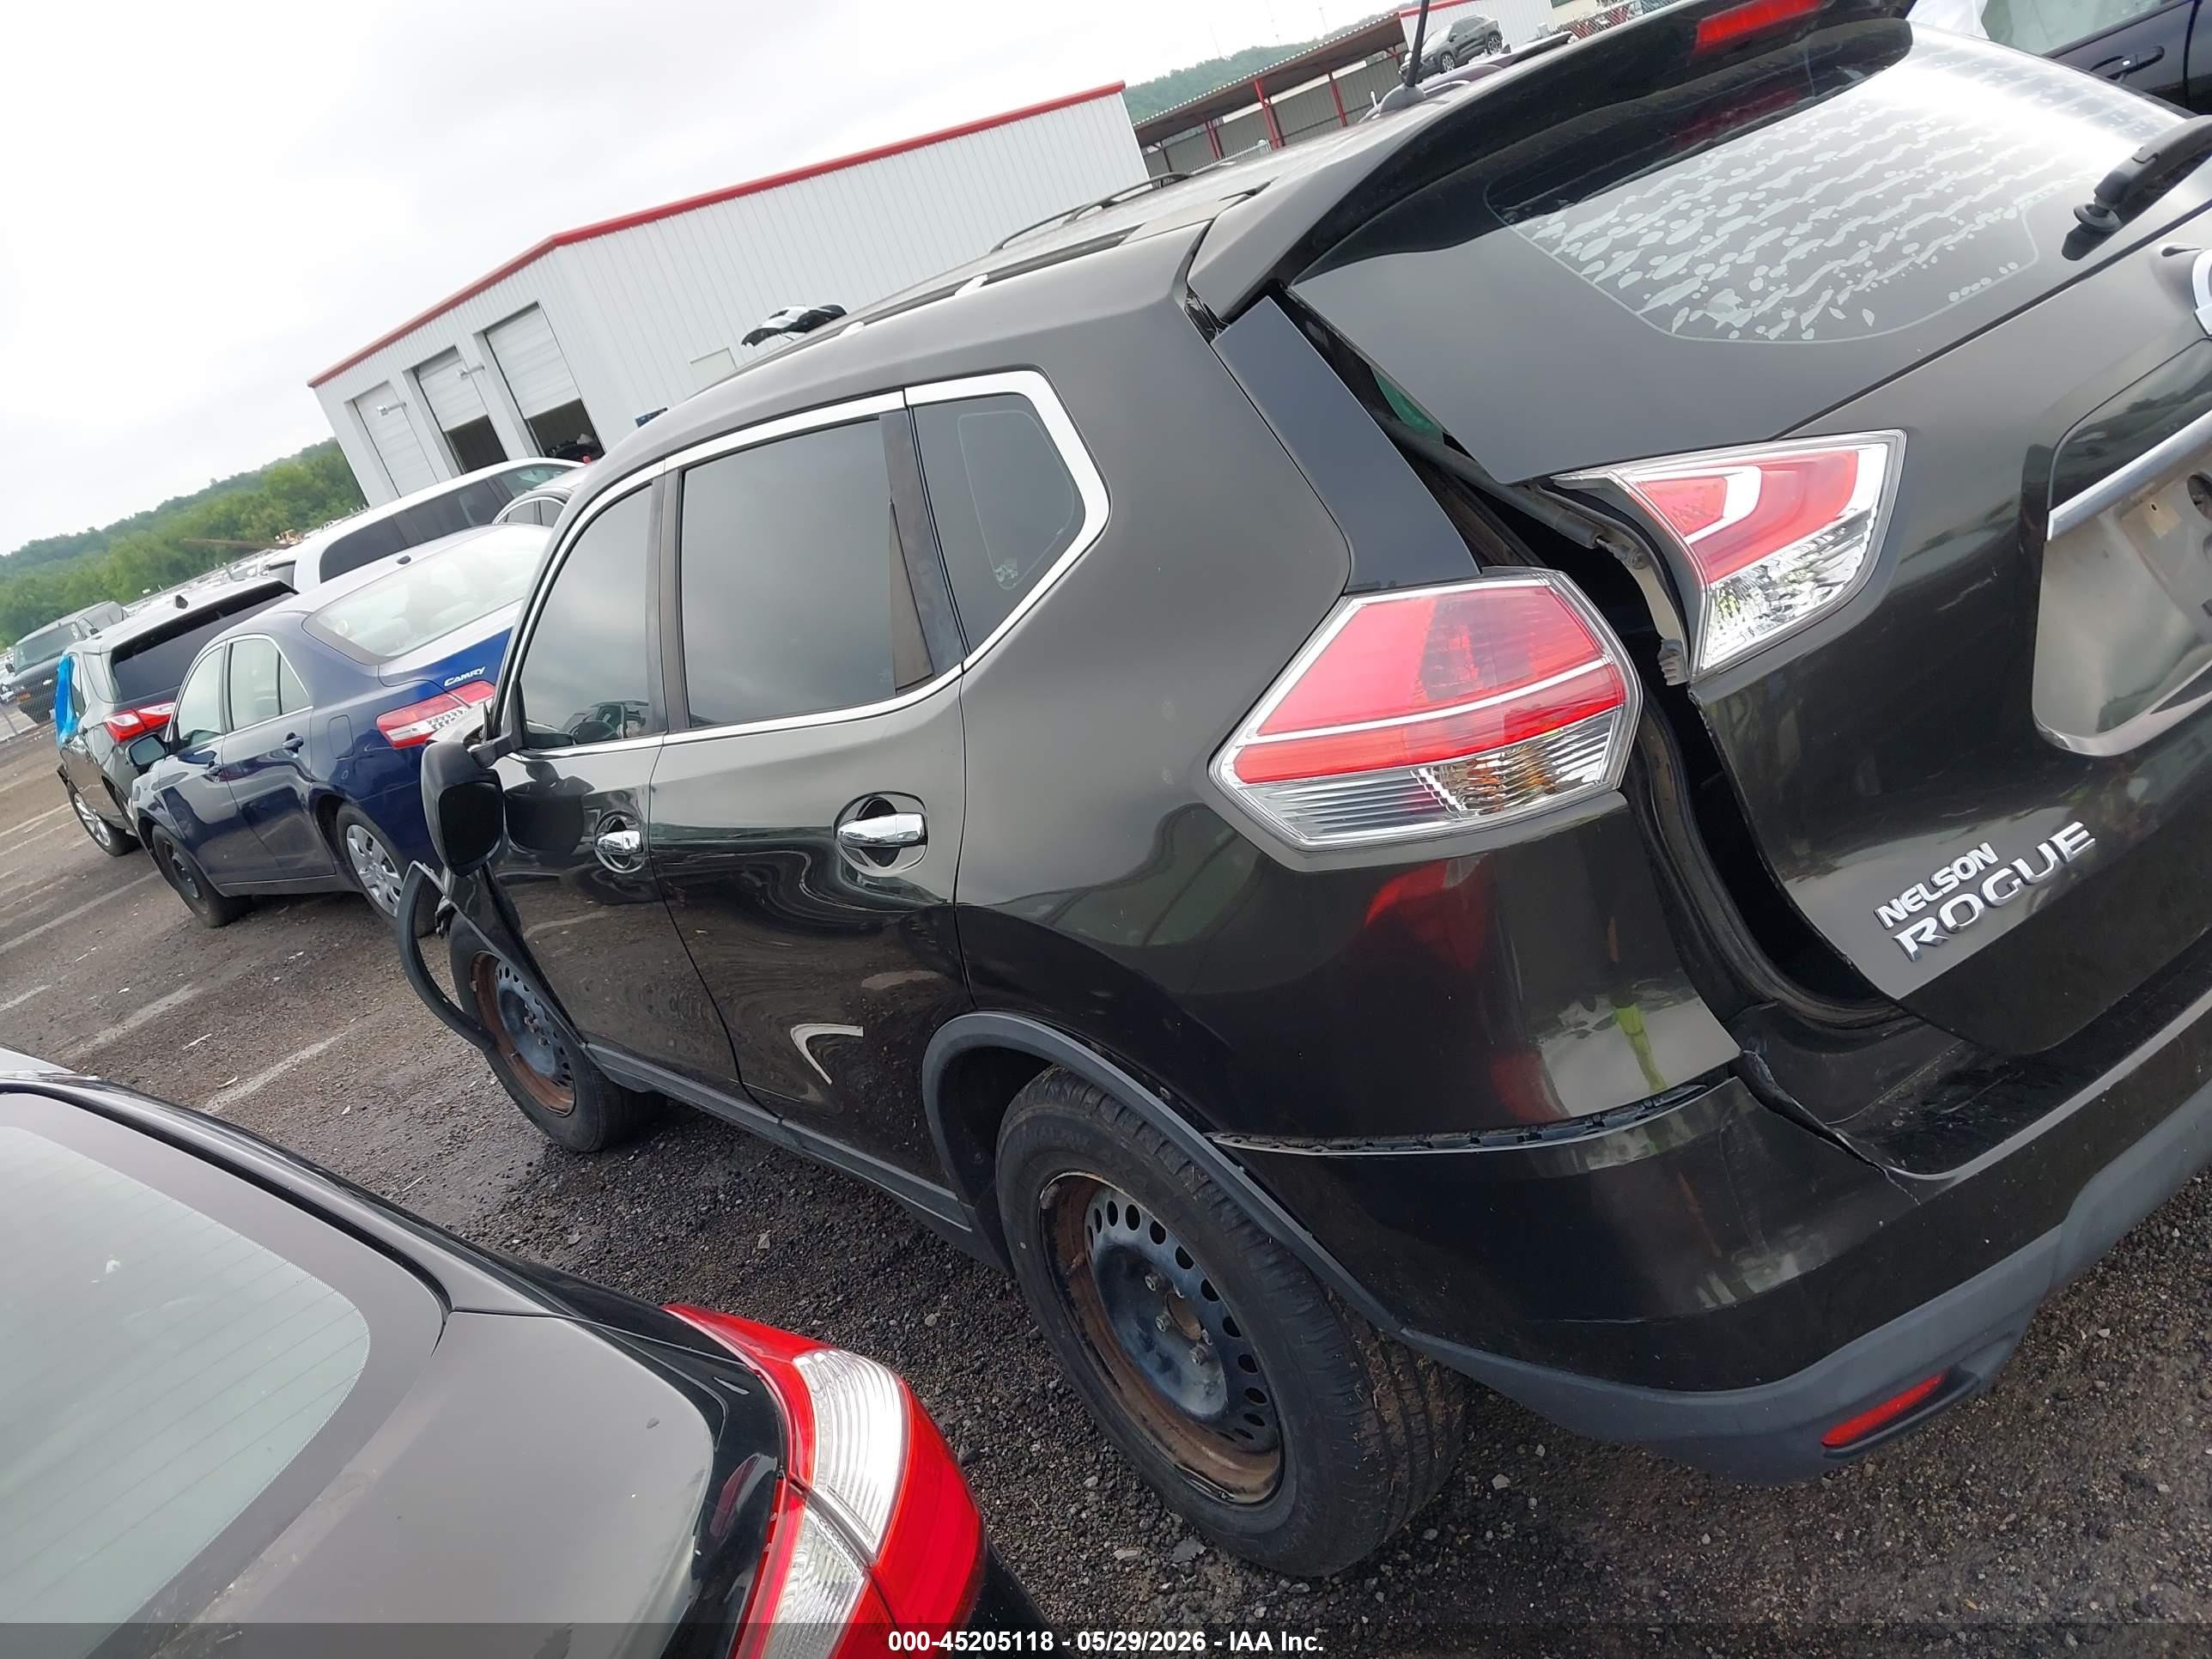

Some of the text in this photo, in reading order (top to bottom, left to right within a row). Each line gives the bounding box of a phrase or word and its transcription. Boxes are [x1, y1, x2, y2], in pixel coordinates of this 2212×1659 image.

[444, 666, 486, 687] CAMRY
[1874, 842, 1999, 929] NELSON
[1892, 821, 2096, 962] ROGUE
